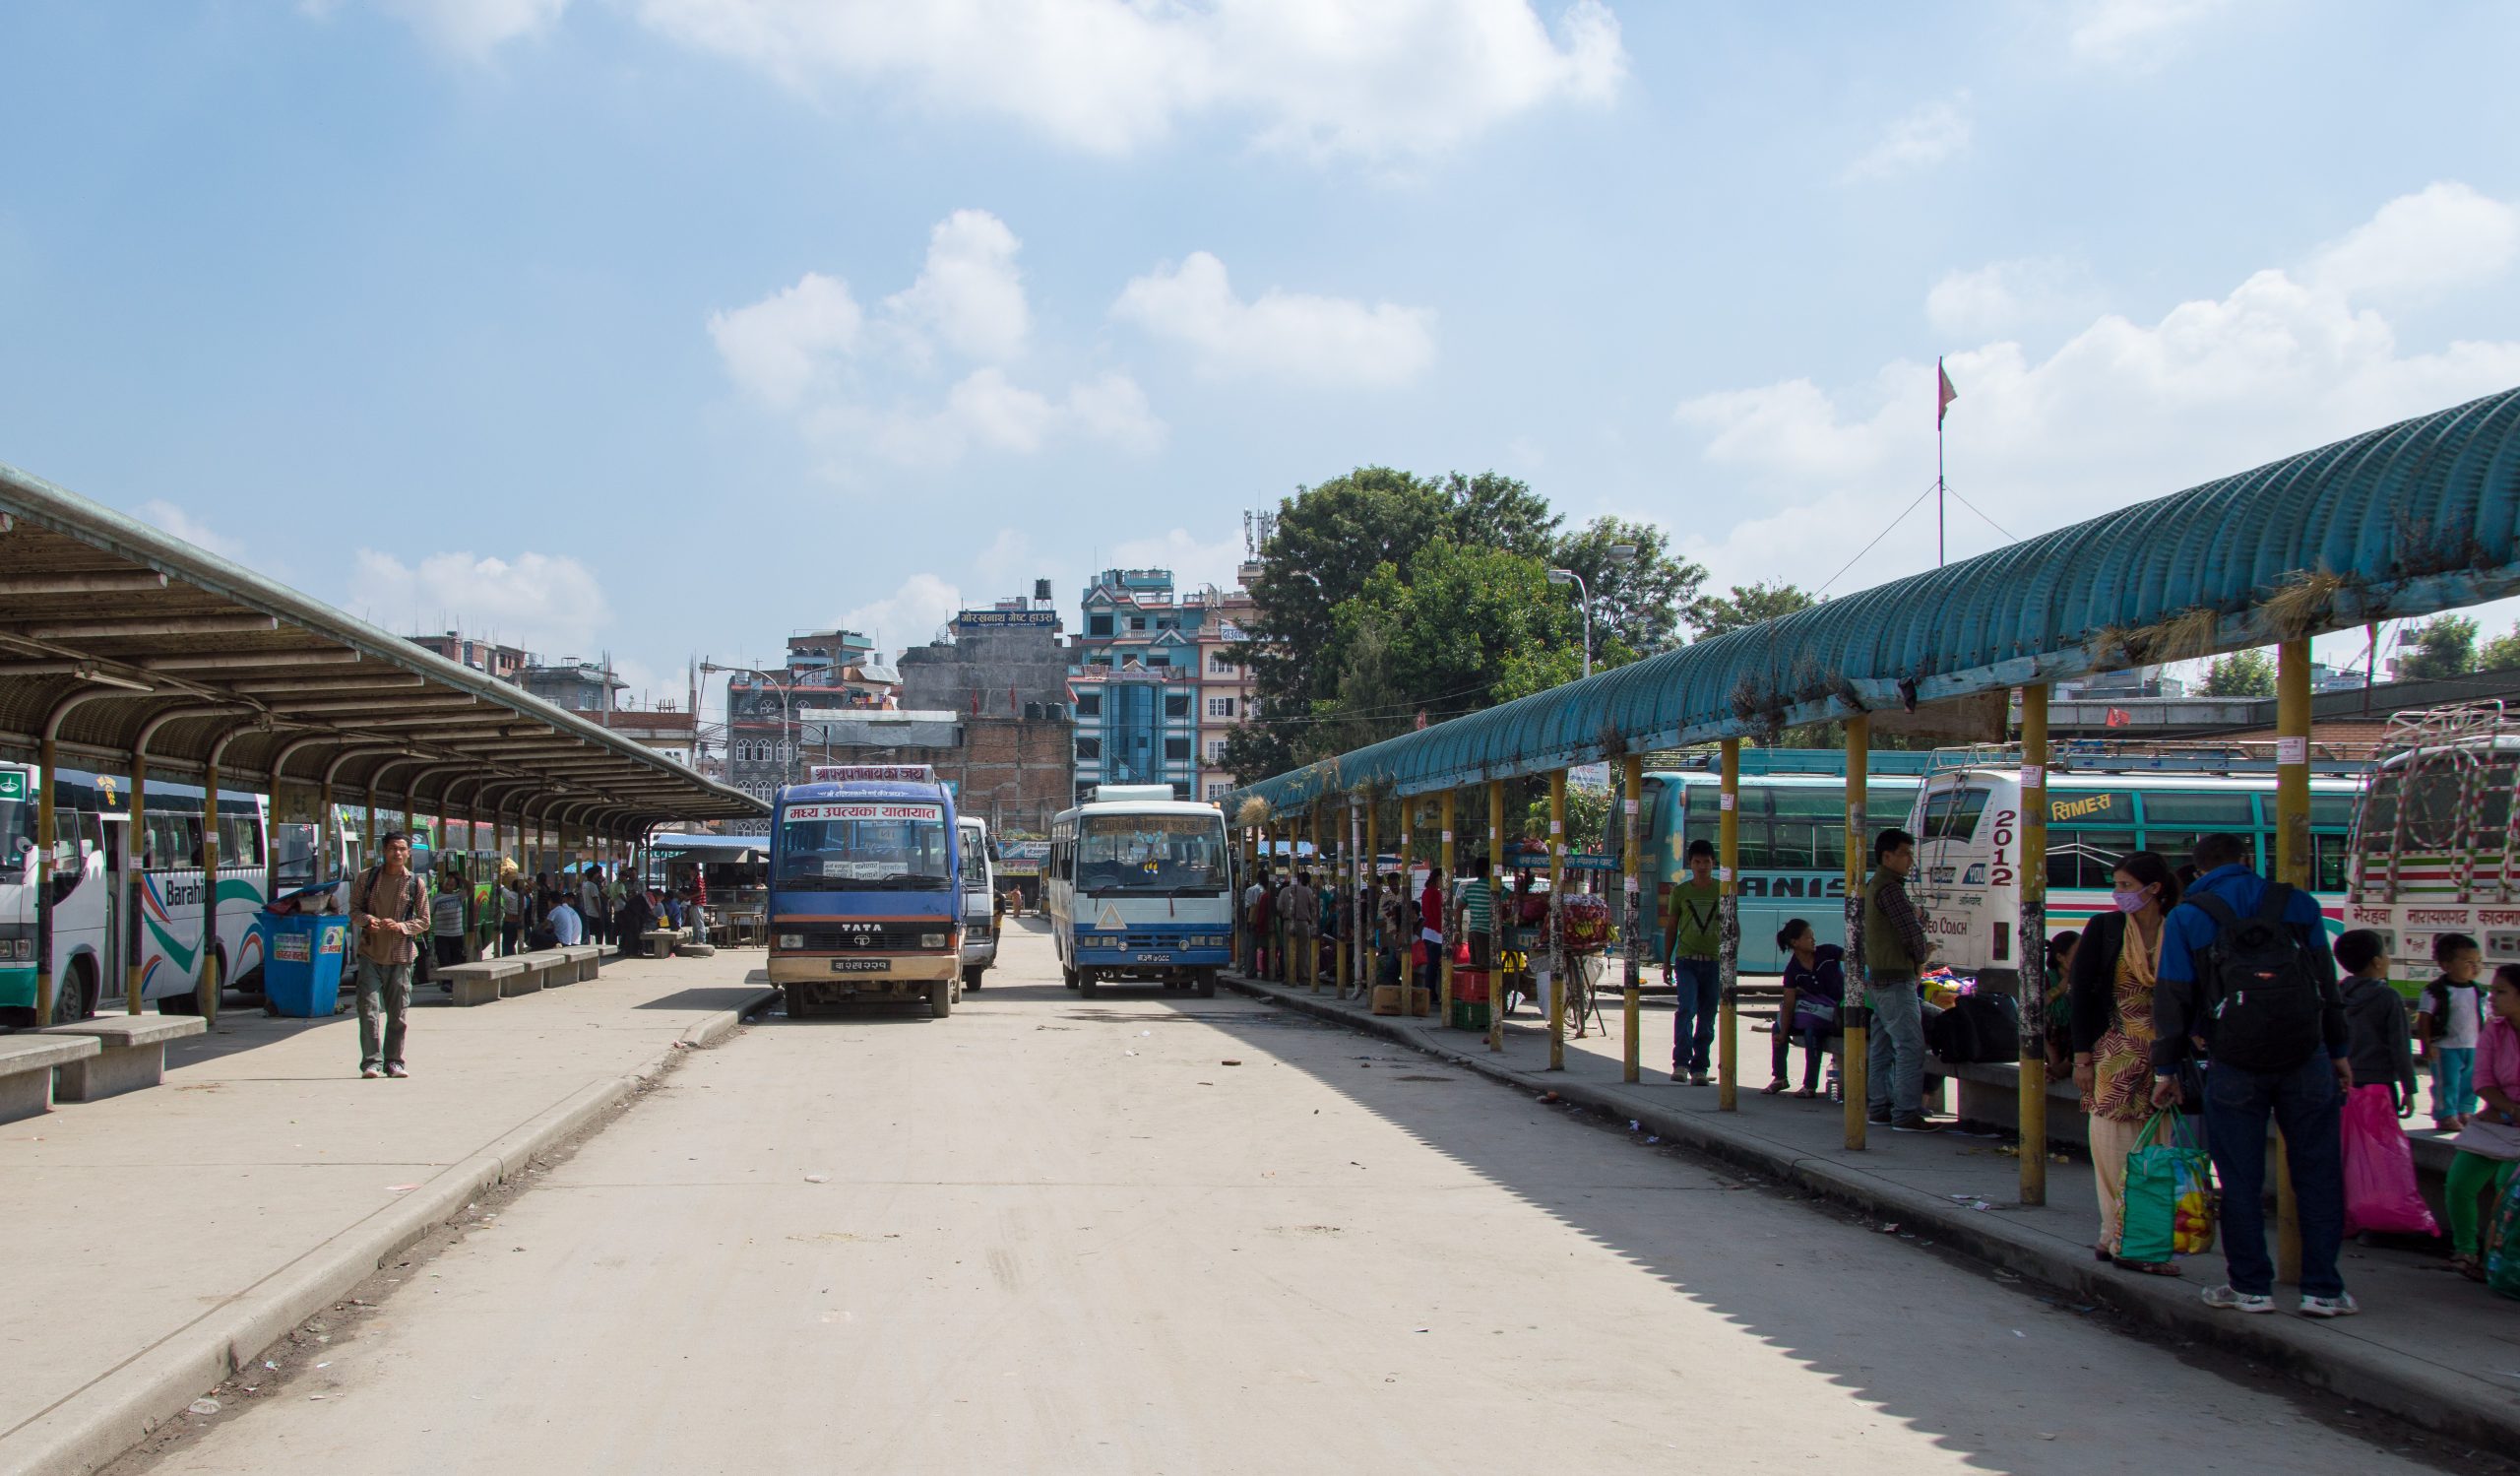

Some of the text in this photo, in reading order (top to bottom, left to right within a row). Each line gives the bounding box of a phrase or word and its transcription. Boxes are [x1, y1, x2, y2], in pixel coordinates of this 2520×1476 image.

[961, 612, 1006, 622] गोरखनाथ
[1029, 613, 1053, 622] हाउस
[789, 806, 937, 819] मध्य उपत्यका यातायात
[1990, 810, 2016, 886] 2012
[1969, 867, 1984, 882] YOU
[166, 878, 205, 907] Barahi
[1736, 877, 1868, 898] ANIS
[2476, 909, 2520, 926] काठमा
